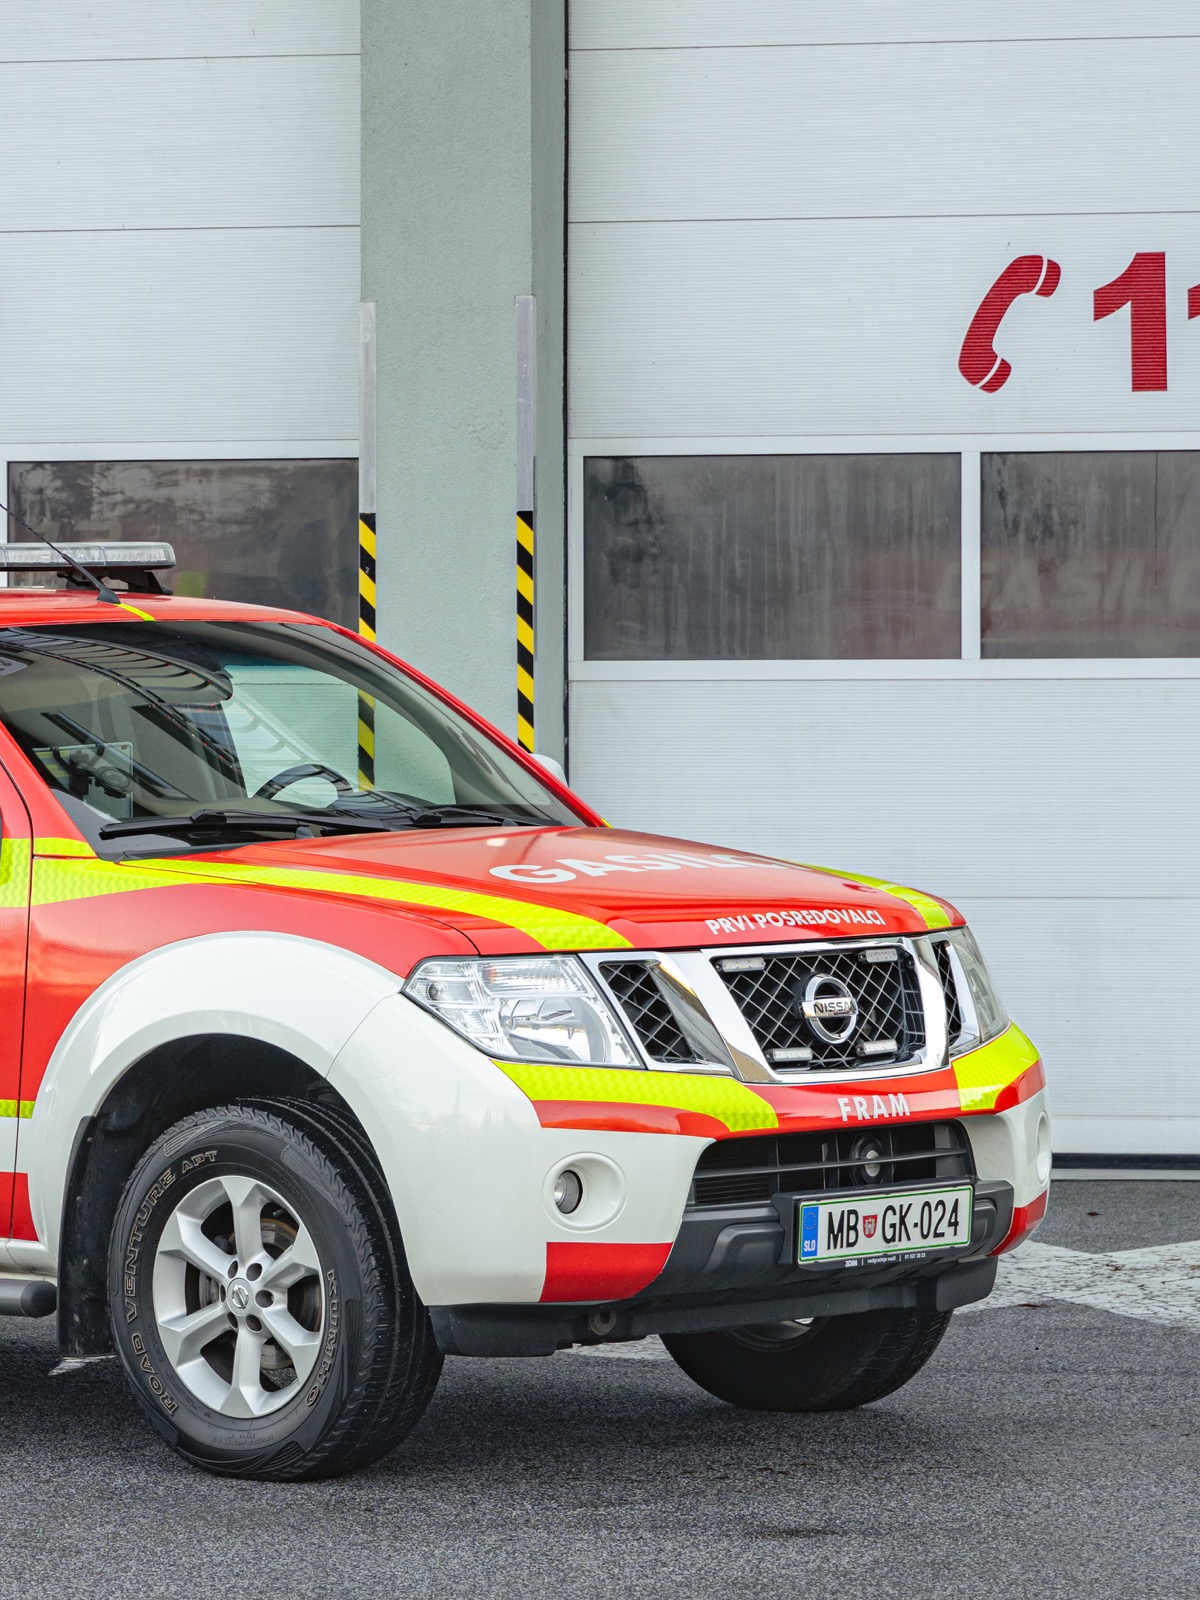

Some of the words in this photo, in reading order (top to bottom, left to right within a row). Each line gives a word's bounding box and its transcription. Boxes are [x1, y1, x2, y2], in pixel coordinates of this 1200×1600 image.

[1093, 251, 1200, 392] 1
[705, 914, 755, 935] PRVI
[752, 909, 886, 929] POSREDOVALCI
[813, 1001, 856, 1014] NISSAN
[837, 1093, 911, 1121] FRAM
[123, 1168, 177, 1324] VENTURE
[803, 1239, 817, 1253] SLO
[827, 1209, 859, 1250] MB
[882, 1198, 960, 1245] GK-024
[306, 1269, 338, 1406] KUMHO
[132, 1332, 179, 1417] ROAD
